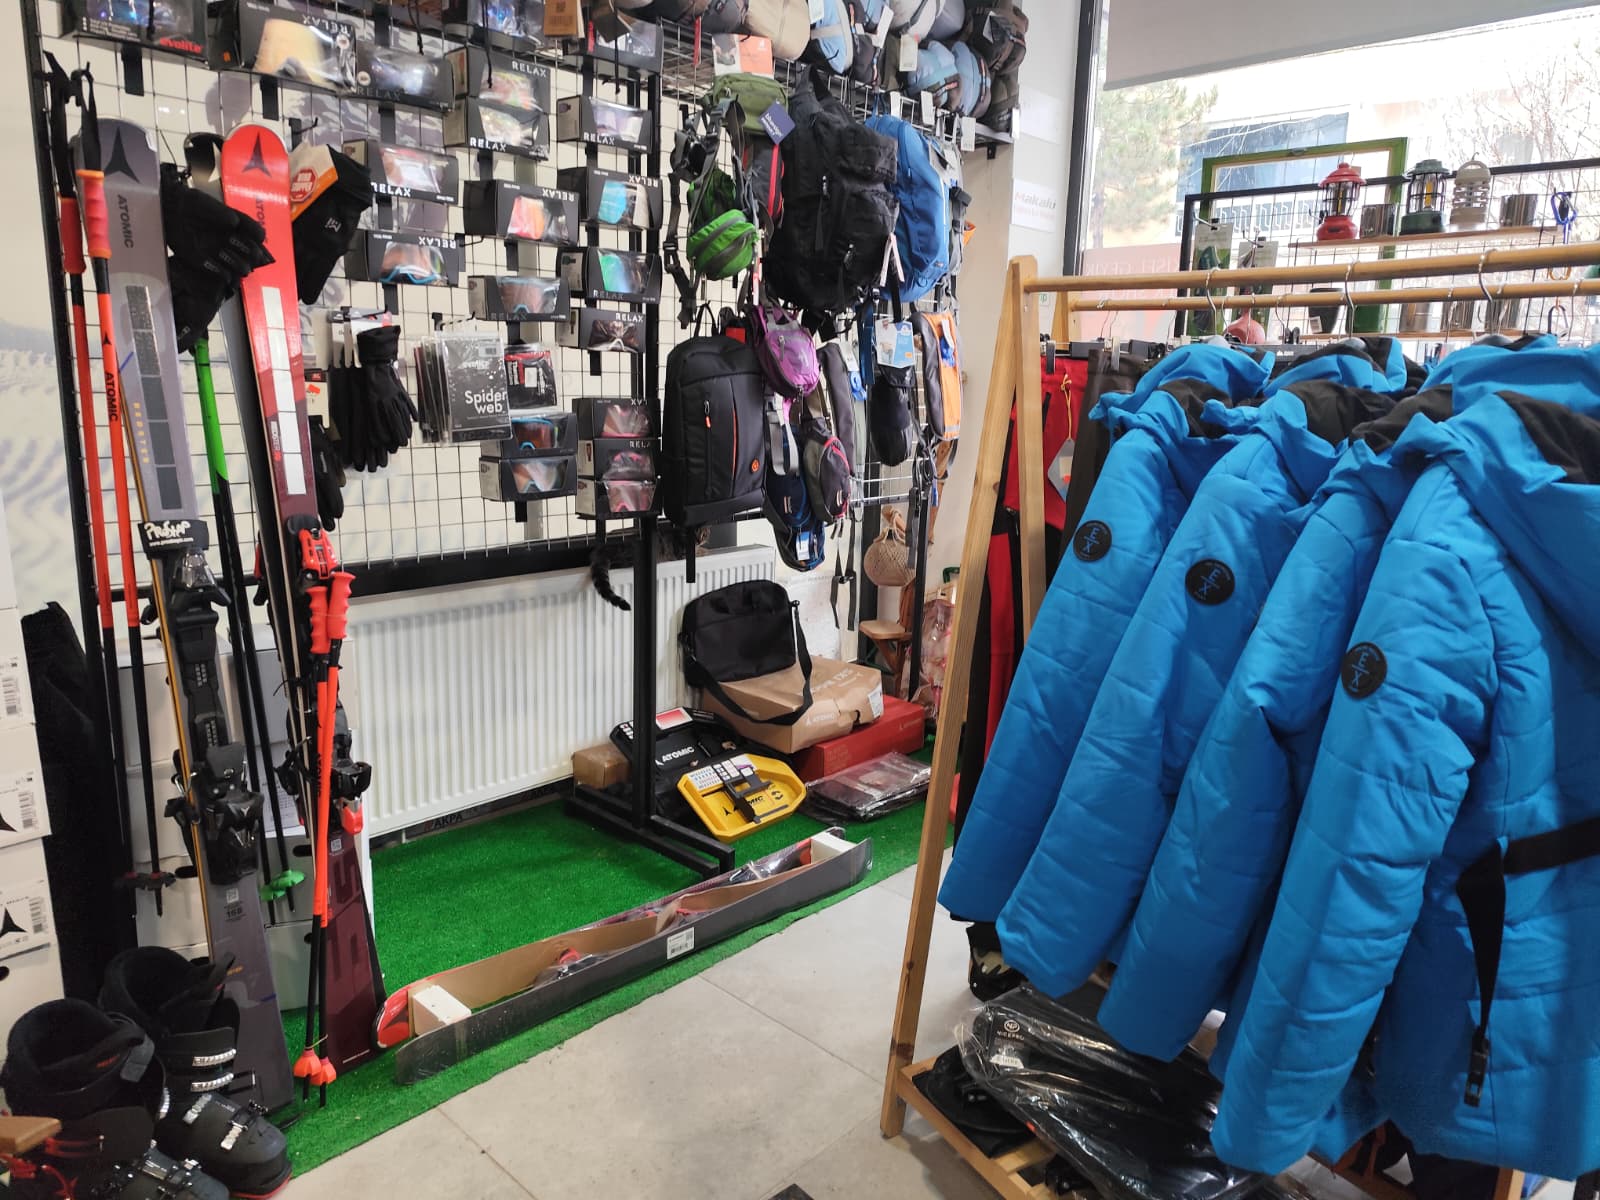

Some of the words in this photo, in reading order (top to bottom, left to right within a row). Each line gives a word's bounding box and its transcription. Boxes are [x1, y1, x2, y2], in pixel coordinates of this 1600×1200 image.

[302, 13, 348, 34] RELAX
[511, 60, 547, 77] RELAX
[469, 136, 507, 152] RELAX
[583, 131, 615, 145] RELAX
[628, 175, 659, 188] RELAX
[370, 182, 411, 197] RELAX
[542, 188, 575, 202] RELAX
[117, 194, 134, 248] ATOMIC
[418, 236, 457, 249] RELAX
[593, 289, 624, 300] RELAX
[615, 312, 644, 322] RELAX
[104, 371, 118, 422] ATOMIC
[464, 388, 507, 406] Spider
[475, 400, 503, 414] web
[661, 746, 694, 763] ATOMIC
